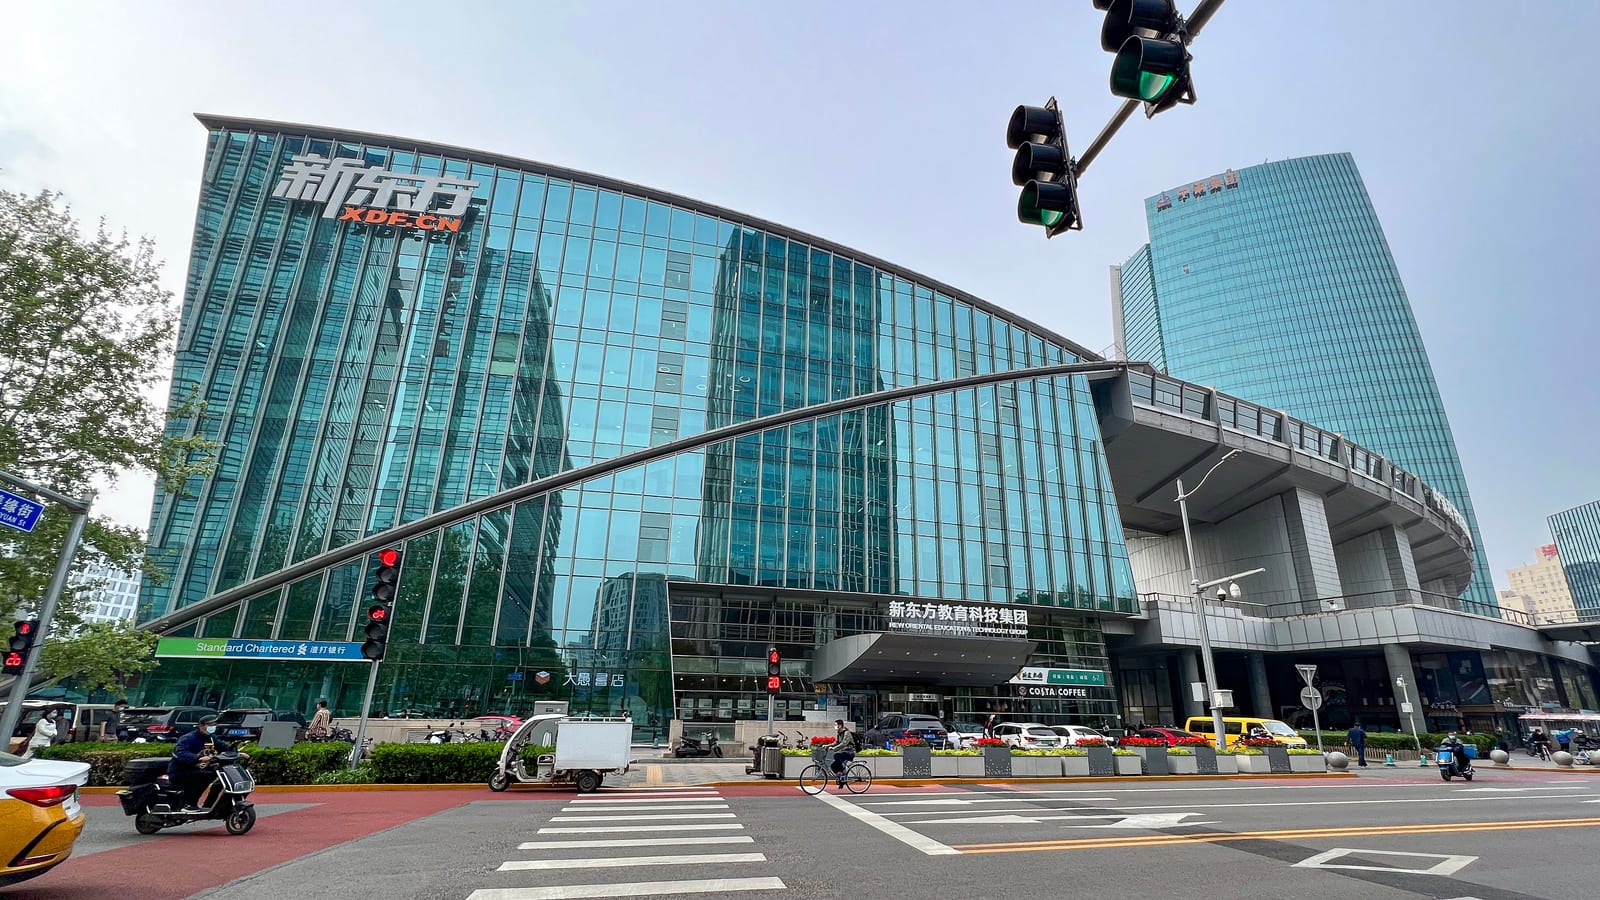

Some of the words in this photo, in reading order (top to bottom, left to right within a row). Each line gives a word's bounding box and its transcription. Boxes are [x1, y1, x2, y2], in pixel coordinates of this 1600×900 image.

[272, 153, 480, 219] 新东方
[340, 206, 463, 233] XDF.CN
[889, 600, 1028, 625] 新东方教育科技集团
[905, 623, 933, 631] ORIENTAL
[197, 643, 243, 653] Standard
[245, 643, 294, 654] Chartered
[310, 646, 346, 655] 渣打银行
[768, 676, 780, 688] 20
[1029, 687, 1055, 696] COSTA
[1058, 688, 1086, 697] COFFEE
